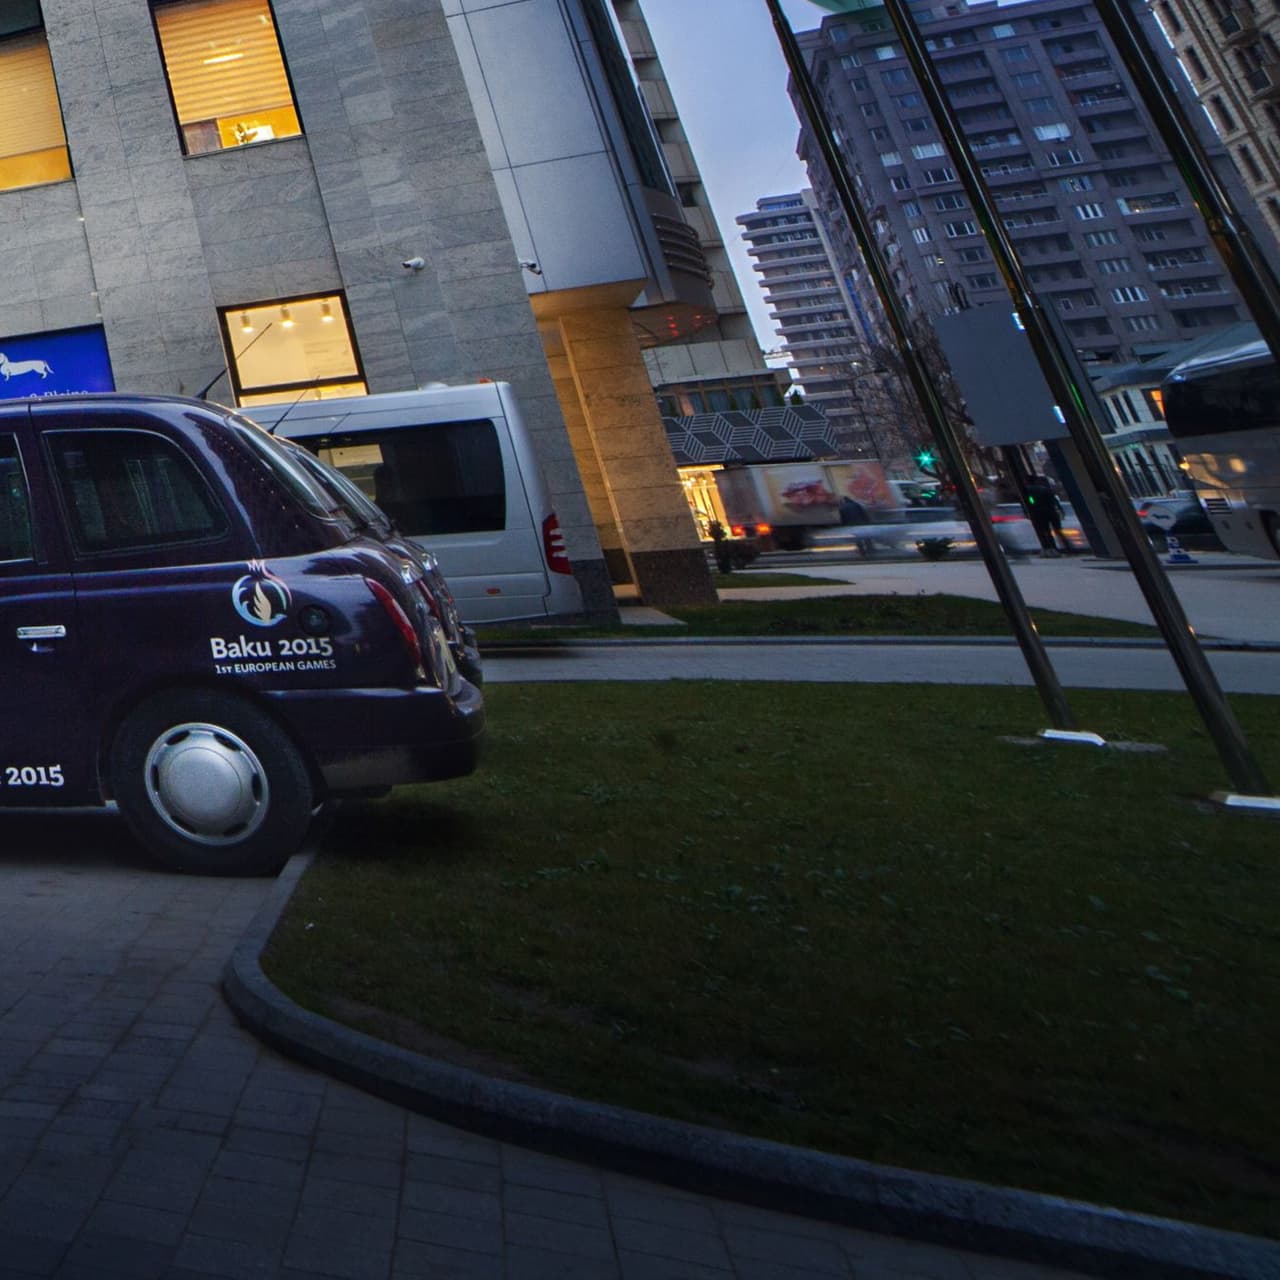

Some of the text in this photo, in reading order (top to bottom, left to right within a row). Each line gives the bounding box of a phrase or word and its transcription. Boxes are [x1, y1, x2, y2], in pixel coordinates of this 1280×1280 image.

[209, 634, 333, 659] Baku 2015
[235, 661, 294, 674] EUROPEAN
[297, 659, 337, 670] GAMES
[5, 764, 65, 787] 2015
